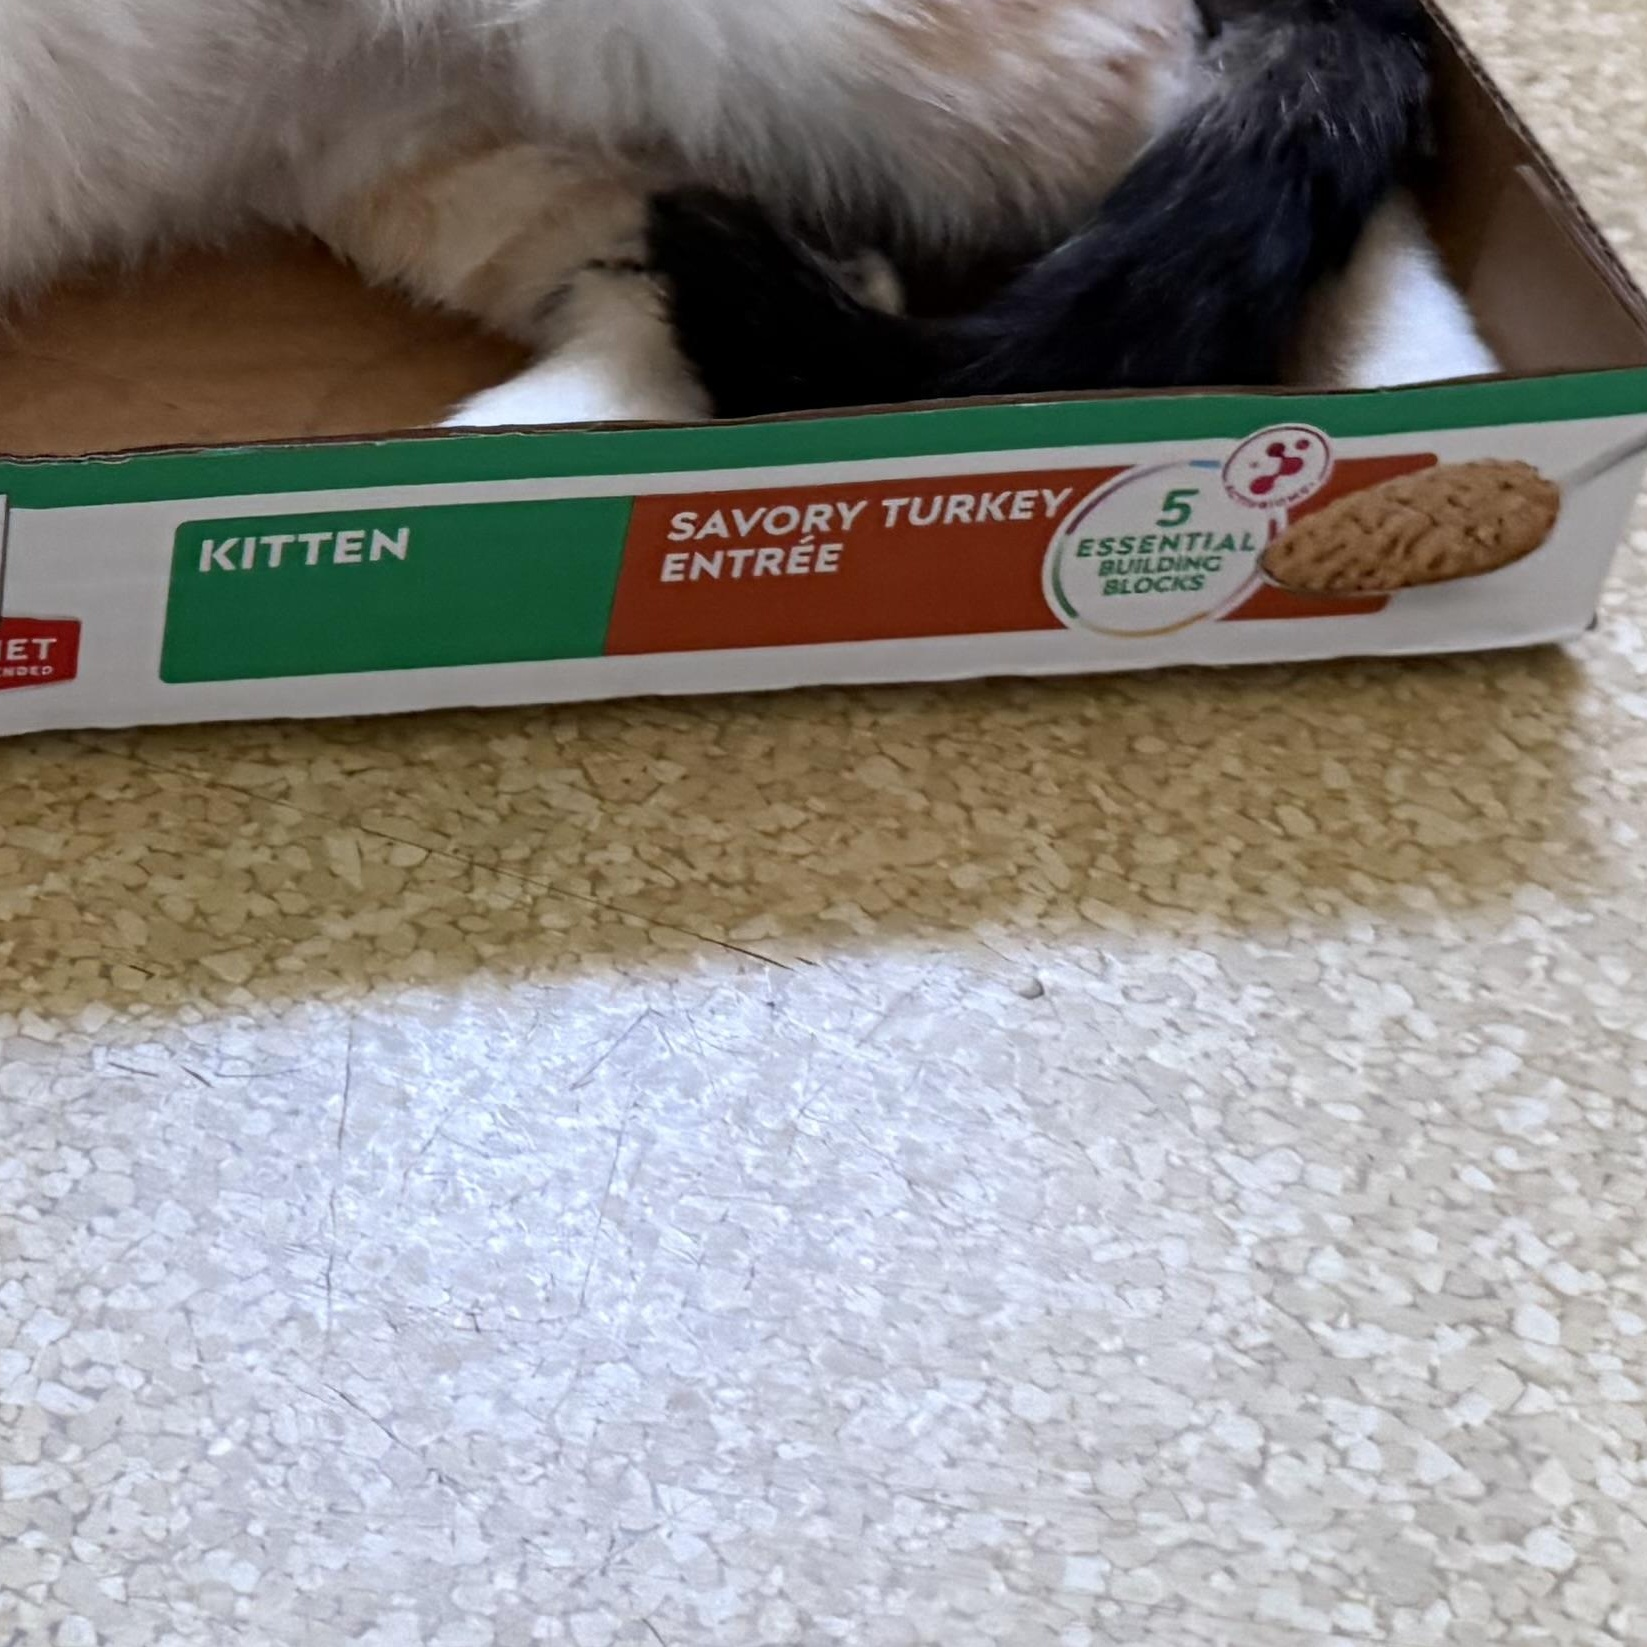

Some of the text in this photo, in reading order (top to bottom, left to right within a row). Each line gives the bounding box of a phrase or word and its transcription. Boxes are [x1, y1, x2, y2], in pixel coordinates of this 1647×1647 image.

[666, 486, 1073, 542] SAVORY TURKEY
[1155, 488, 1200, 528] 5
[198, 526, 410, 573] KITTEN
[659, 535, 844, 583] ENTRÉE
[1075, 531, 1256, 558] ESSENTIAL
[1098, 555, 1223, 577] BUILDING
[1103, 574, 1205, 596] BLOCKS
